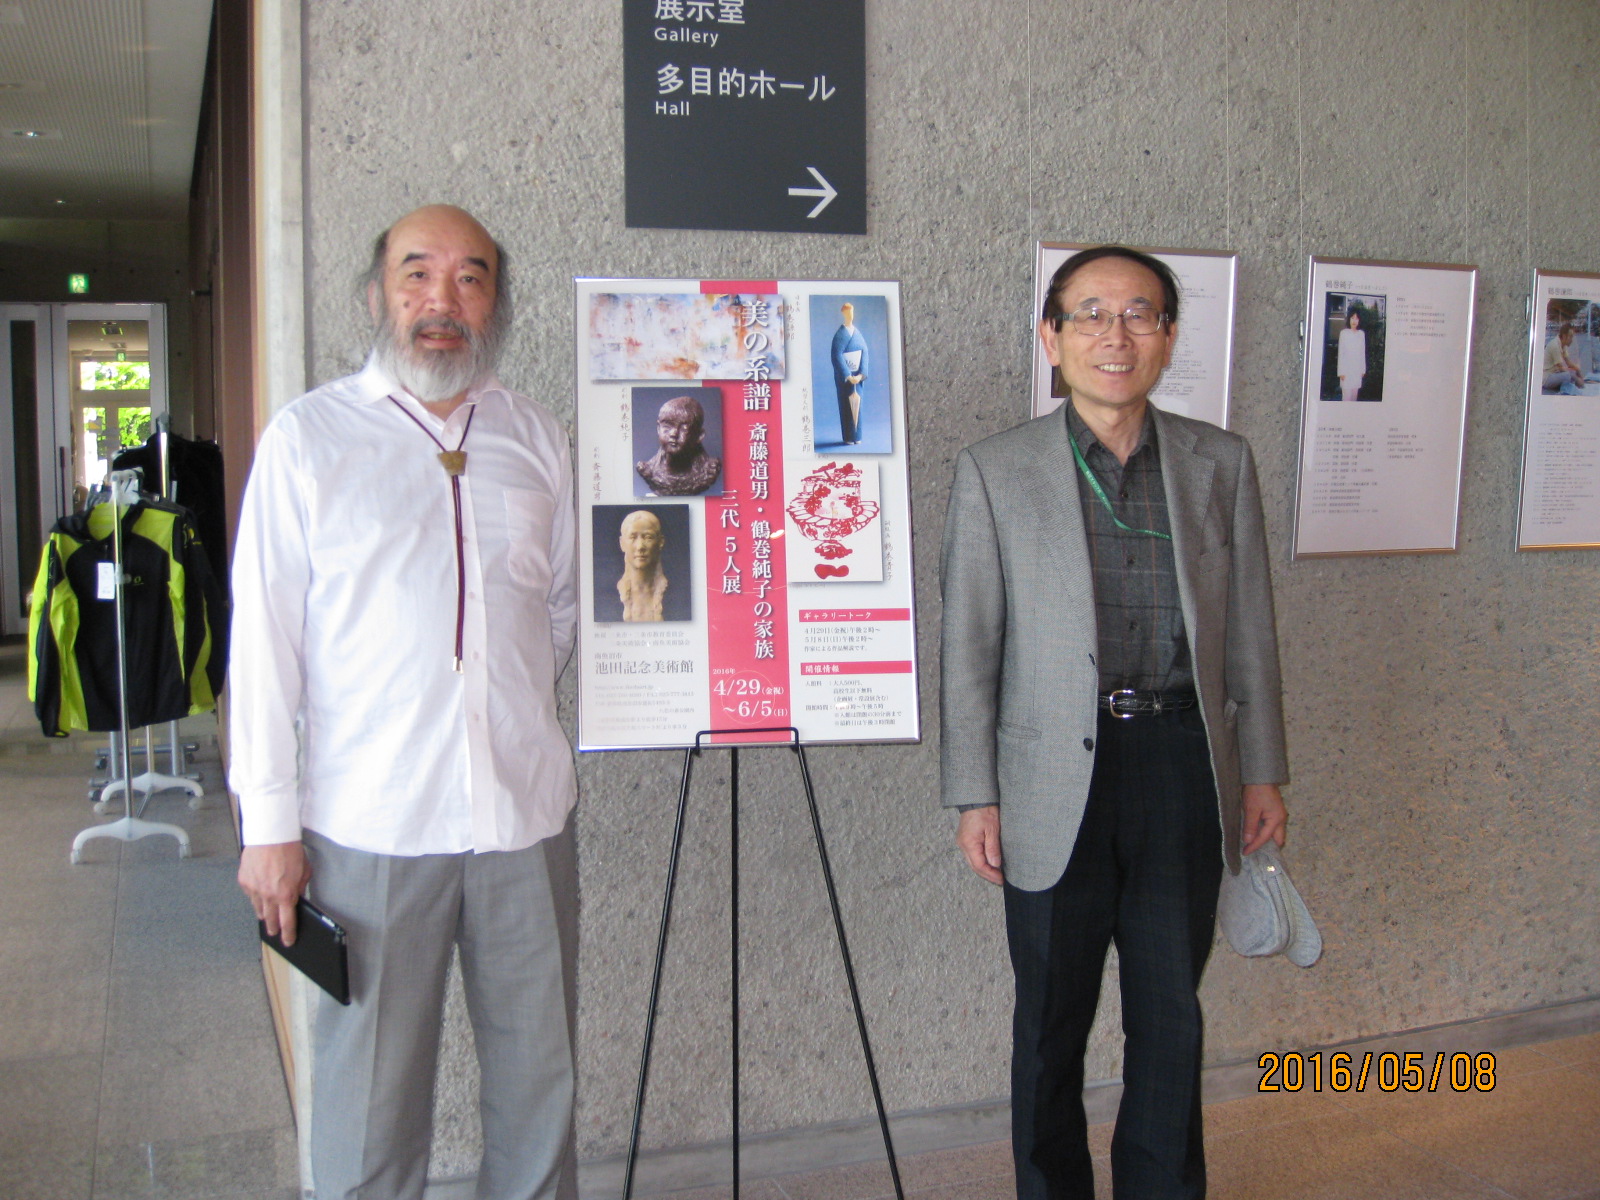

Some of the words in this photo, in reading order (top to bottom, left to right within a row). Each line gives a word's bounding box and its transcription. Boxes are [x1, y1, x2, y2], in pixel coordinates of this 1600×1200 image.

[655, 0, 745, 24] 展示室
[654, 27, 719, 47] Gallery
[657, 63, 836, 101] 多目的ホール
[655, 101, 690, 116] Hall
[742, 301, 771, 411] 美の系譜
[803, 611, 872, 620] ギャラリートーク
[595, 659, 694, 675] 池田記念美術館
[713, 667, 736, 676] 2016年
[805, 663, 840, 673] 開催情報
